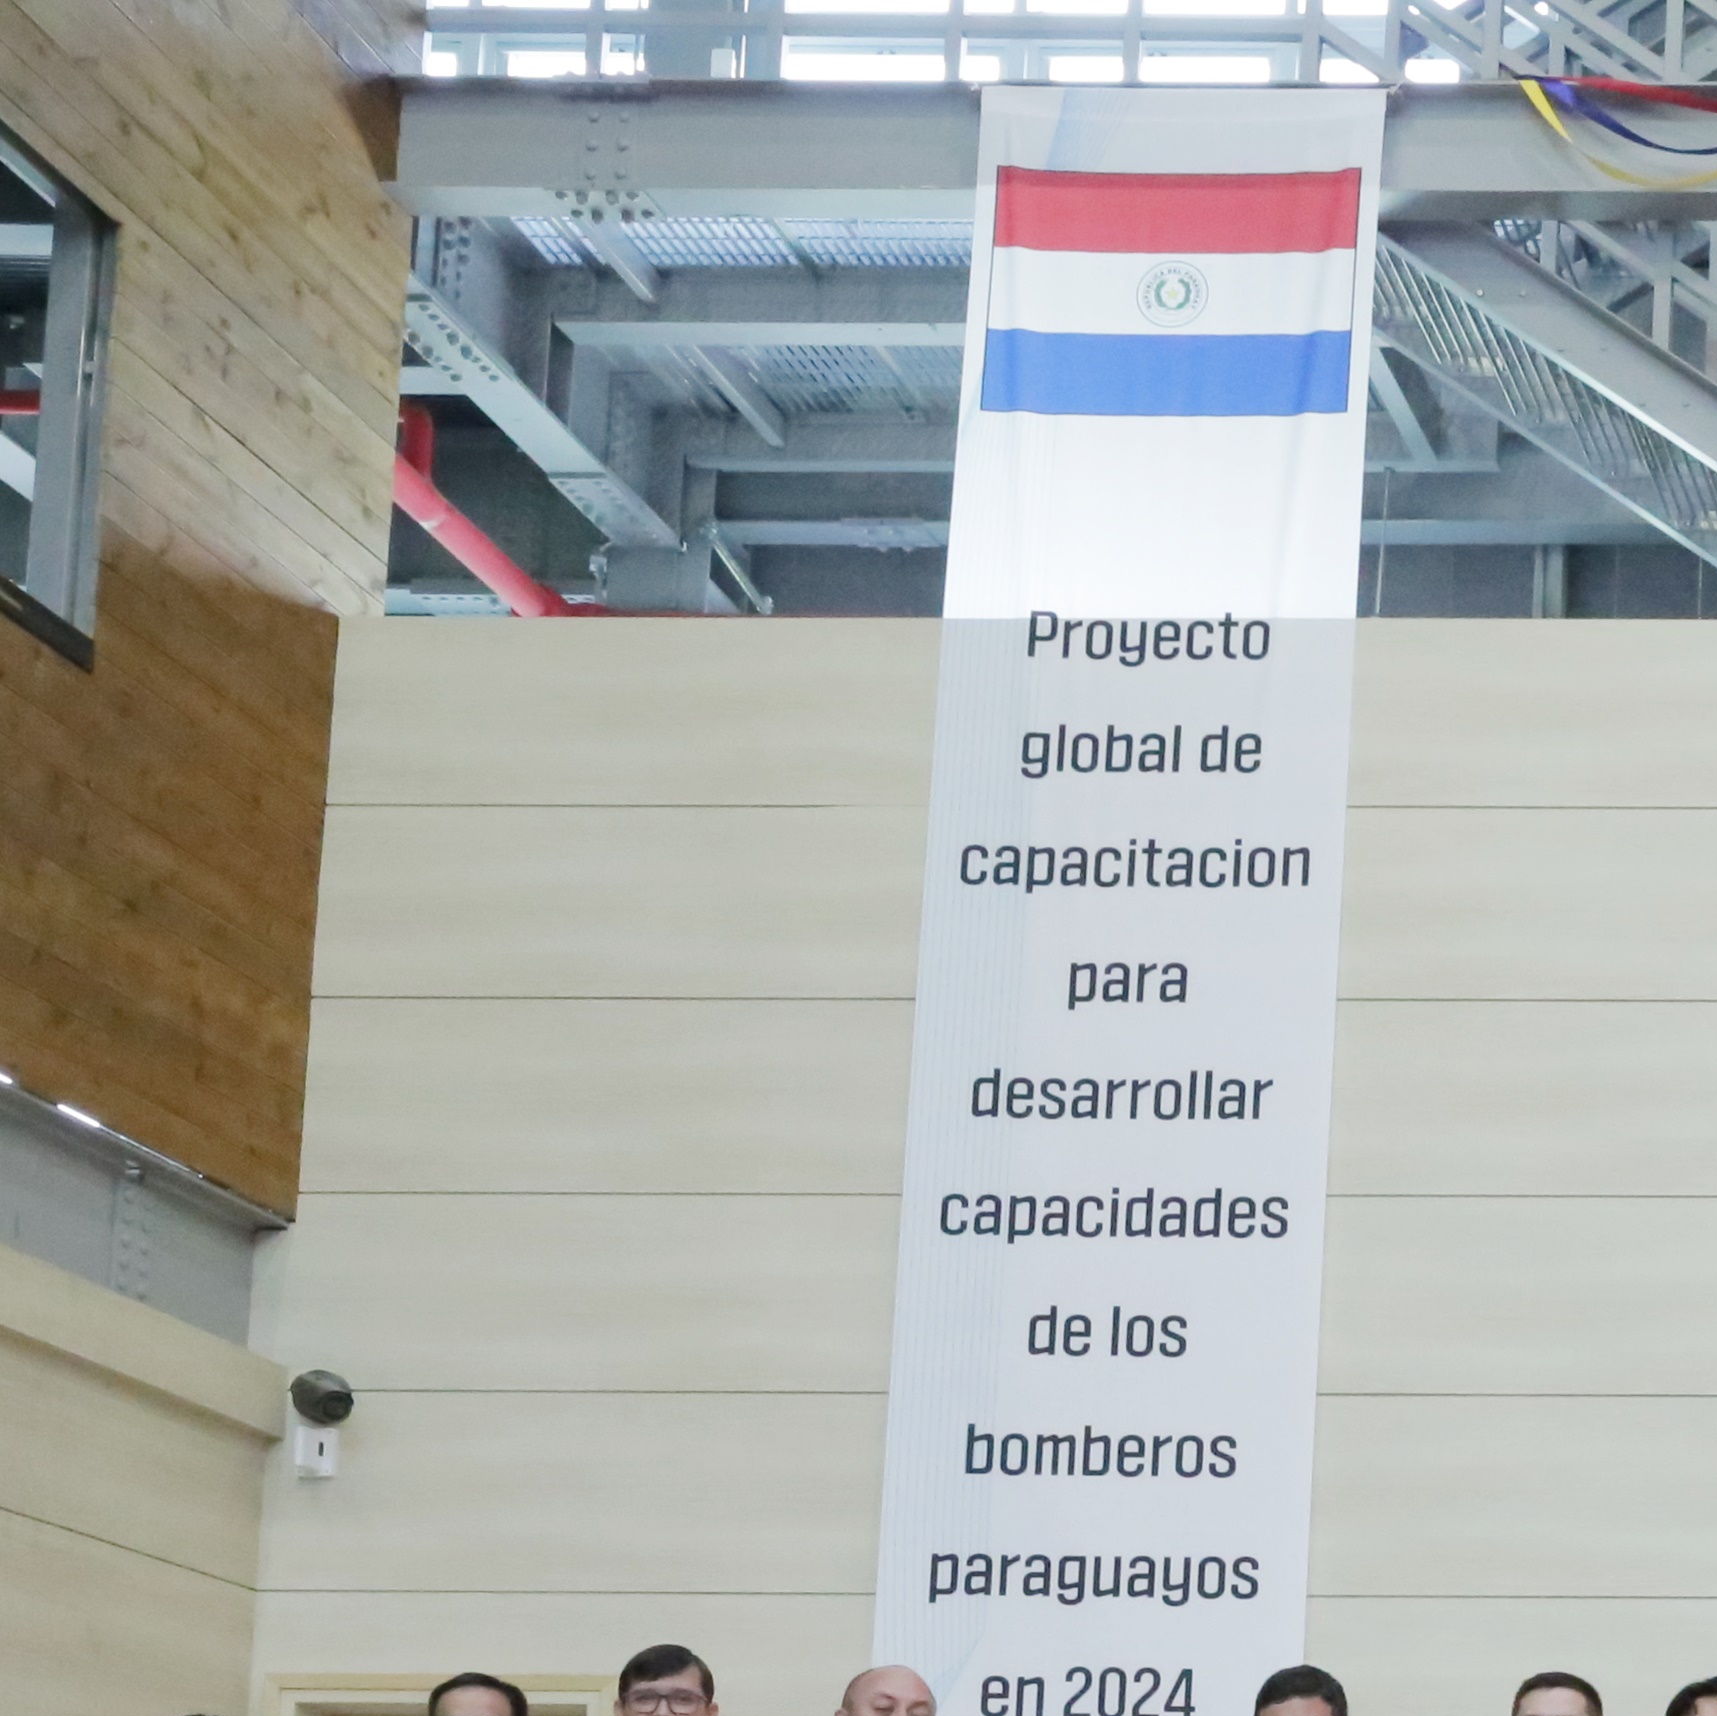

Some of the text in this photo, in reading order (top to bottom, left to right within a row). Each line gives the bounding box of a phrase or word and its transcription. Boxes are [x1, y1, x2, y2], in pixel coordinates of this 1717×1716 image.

[1027, 611, 1270, 667] Proyecto
[1021, 724, 1262, 779] global de
[960, 837, 1311, 894] capacitacion
[1067, 961, 1188, 1011] para
[971, 1068, 1274, 1121] desarrollar
[940, 1187, 1289, 1245] capacidades
[1028, 1305, 1188, 1358] de los
[965, 1423, 1237, 1479] bomberos
[928, 1552, 1260, 1607] paraguayos
